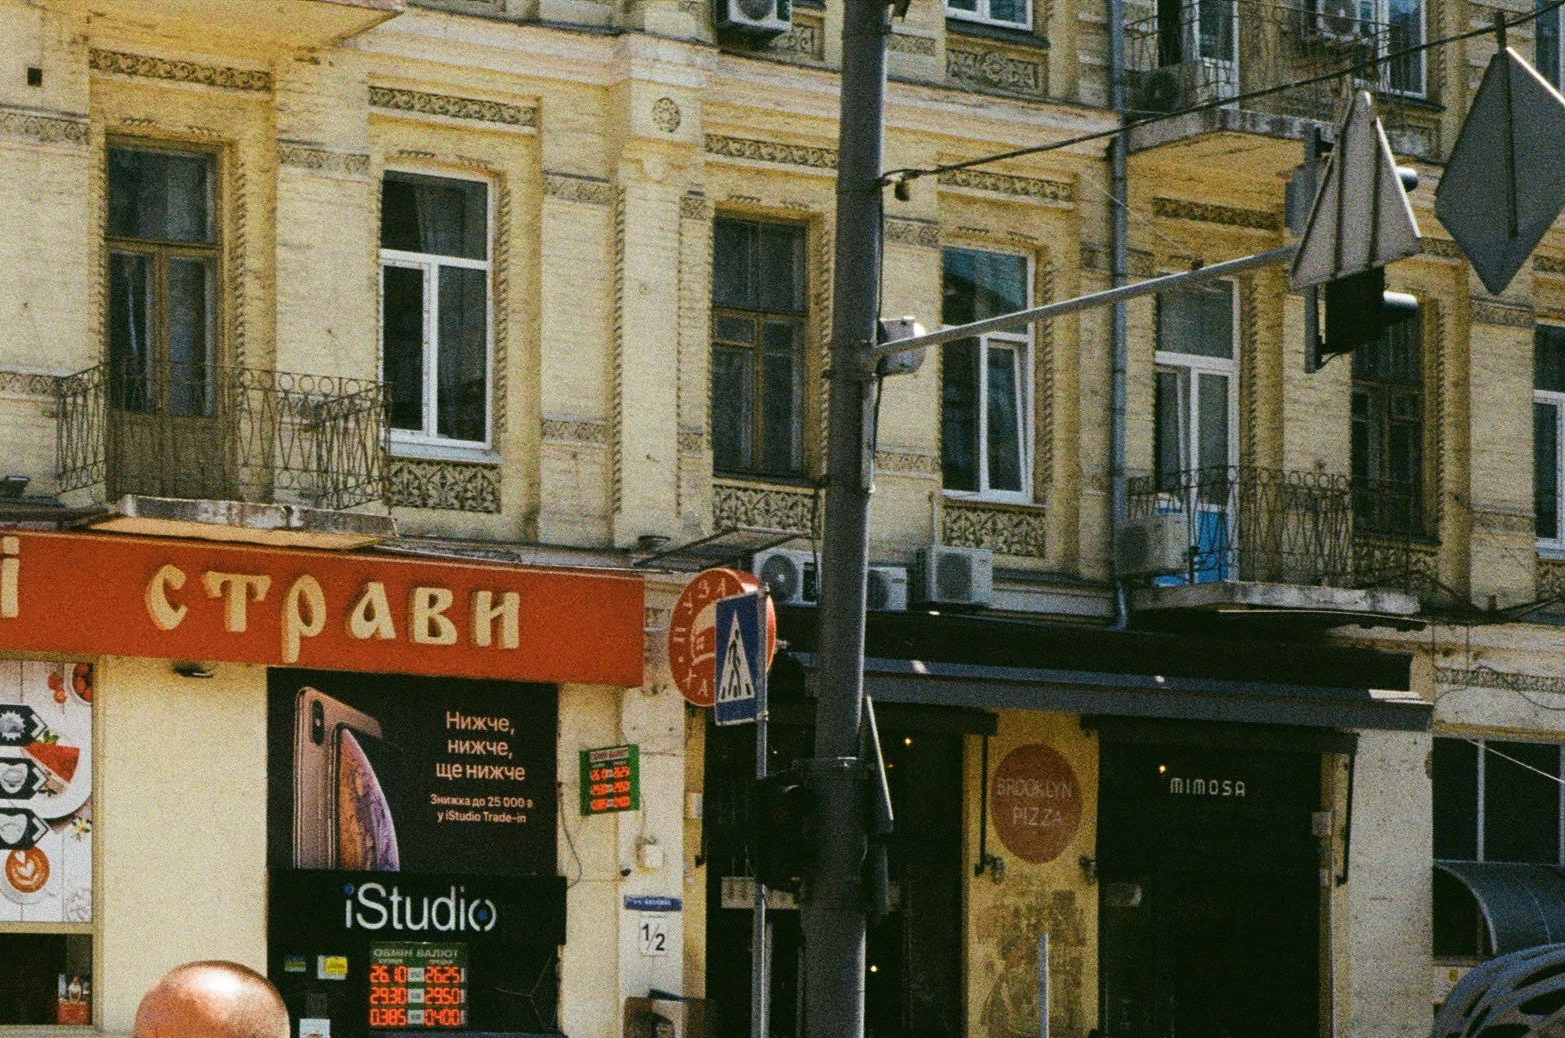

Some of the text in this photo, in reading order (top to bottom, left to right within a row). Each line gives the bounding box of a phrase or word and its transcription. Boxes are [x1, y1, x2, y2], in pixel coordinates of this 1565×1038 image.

[446, 711, 515, 735] Нижче,
[447, 739, 513, 759] нижче,
[436, 763, 525, 780] ще нижче
[997, 778, 1073, 799] BROOKLYN
[430, 793, 471, 805] Знижка
[472, 797, 486, 808] до
[487, 796, 501, 807] 25
[503, 797, 525, 808] 000
[445, 810, 481, 821] iStudio
[483, 811, 526, 823] Trade-in
[1012, 806, 1063, 827] PIZZA
[343, 883, 497, 932] iStudio
[416, 949, 458, 958] ВАЛЮТ
